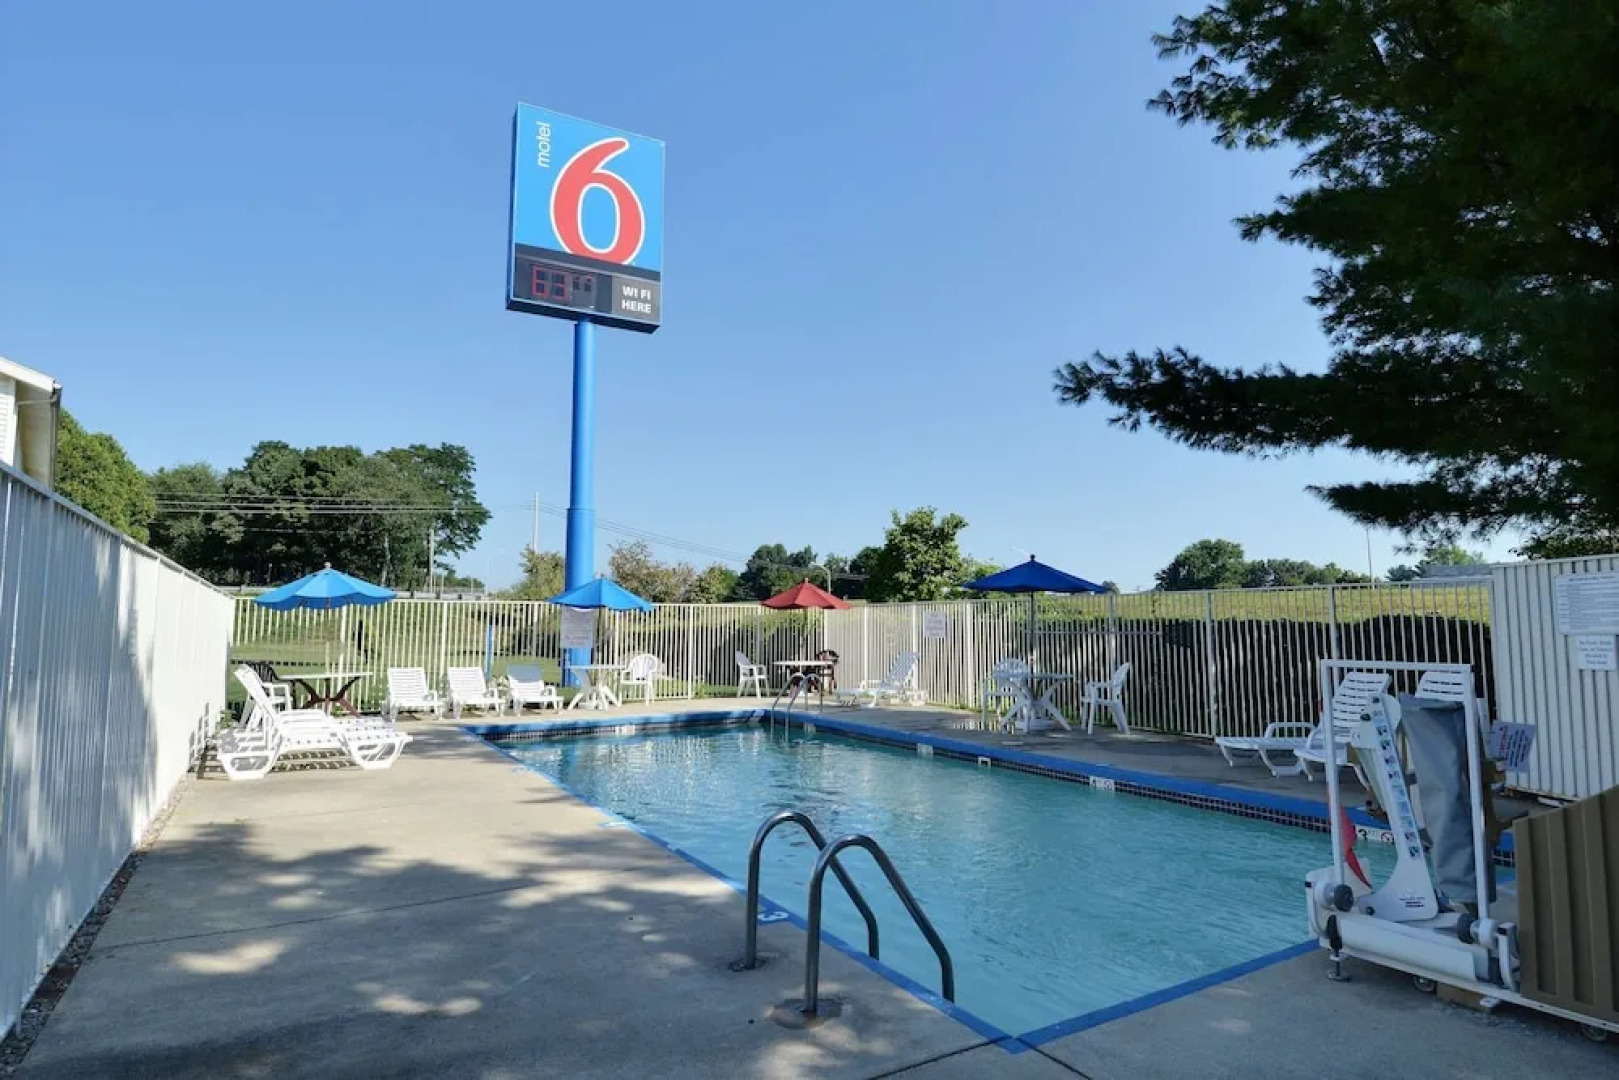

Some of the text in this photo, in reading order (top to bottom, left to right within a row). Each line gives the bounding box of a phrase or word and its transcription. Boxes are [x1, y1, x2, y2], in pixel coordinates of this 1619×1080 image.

[536, 120, 551, 168] motel
[550, 136, 645, 265] 6
[621, 284, 652, 301] WI FI
[621, 299, 652, 314] HERE
